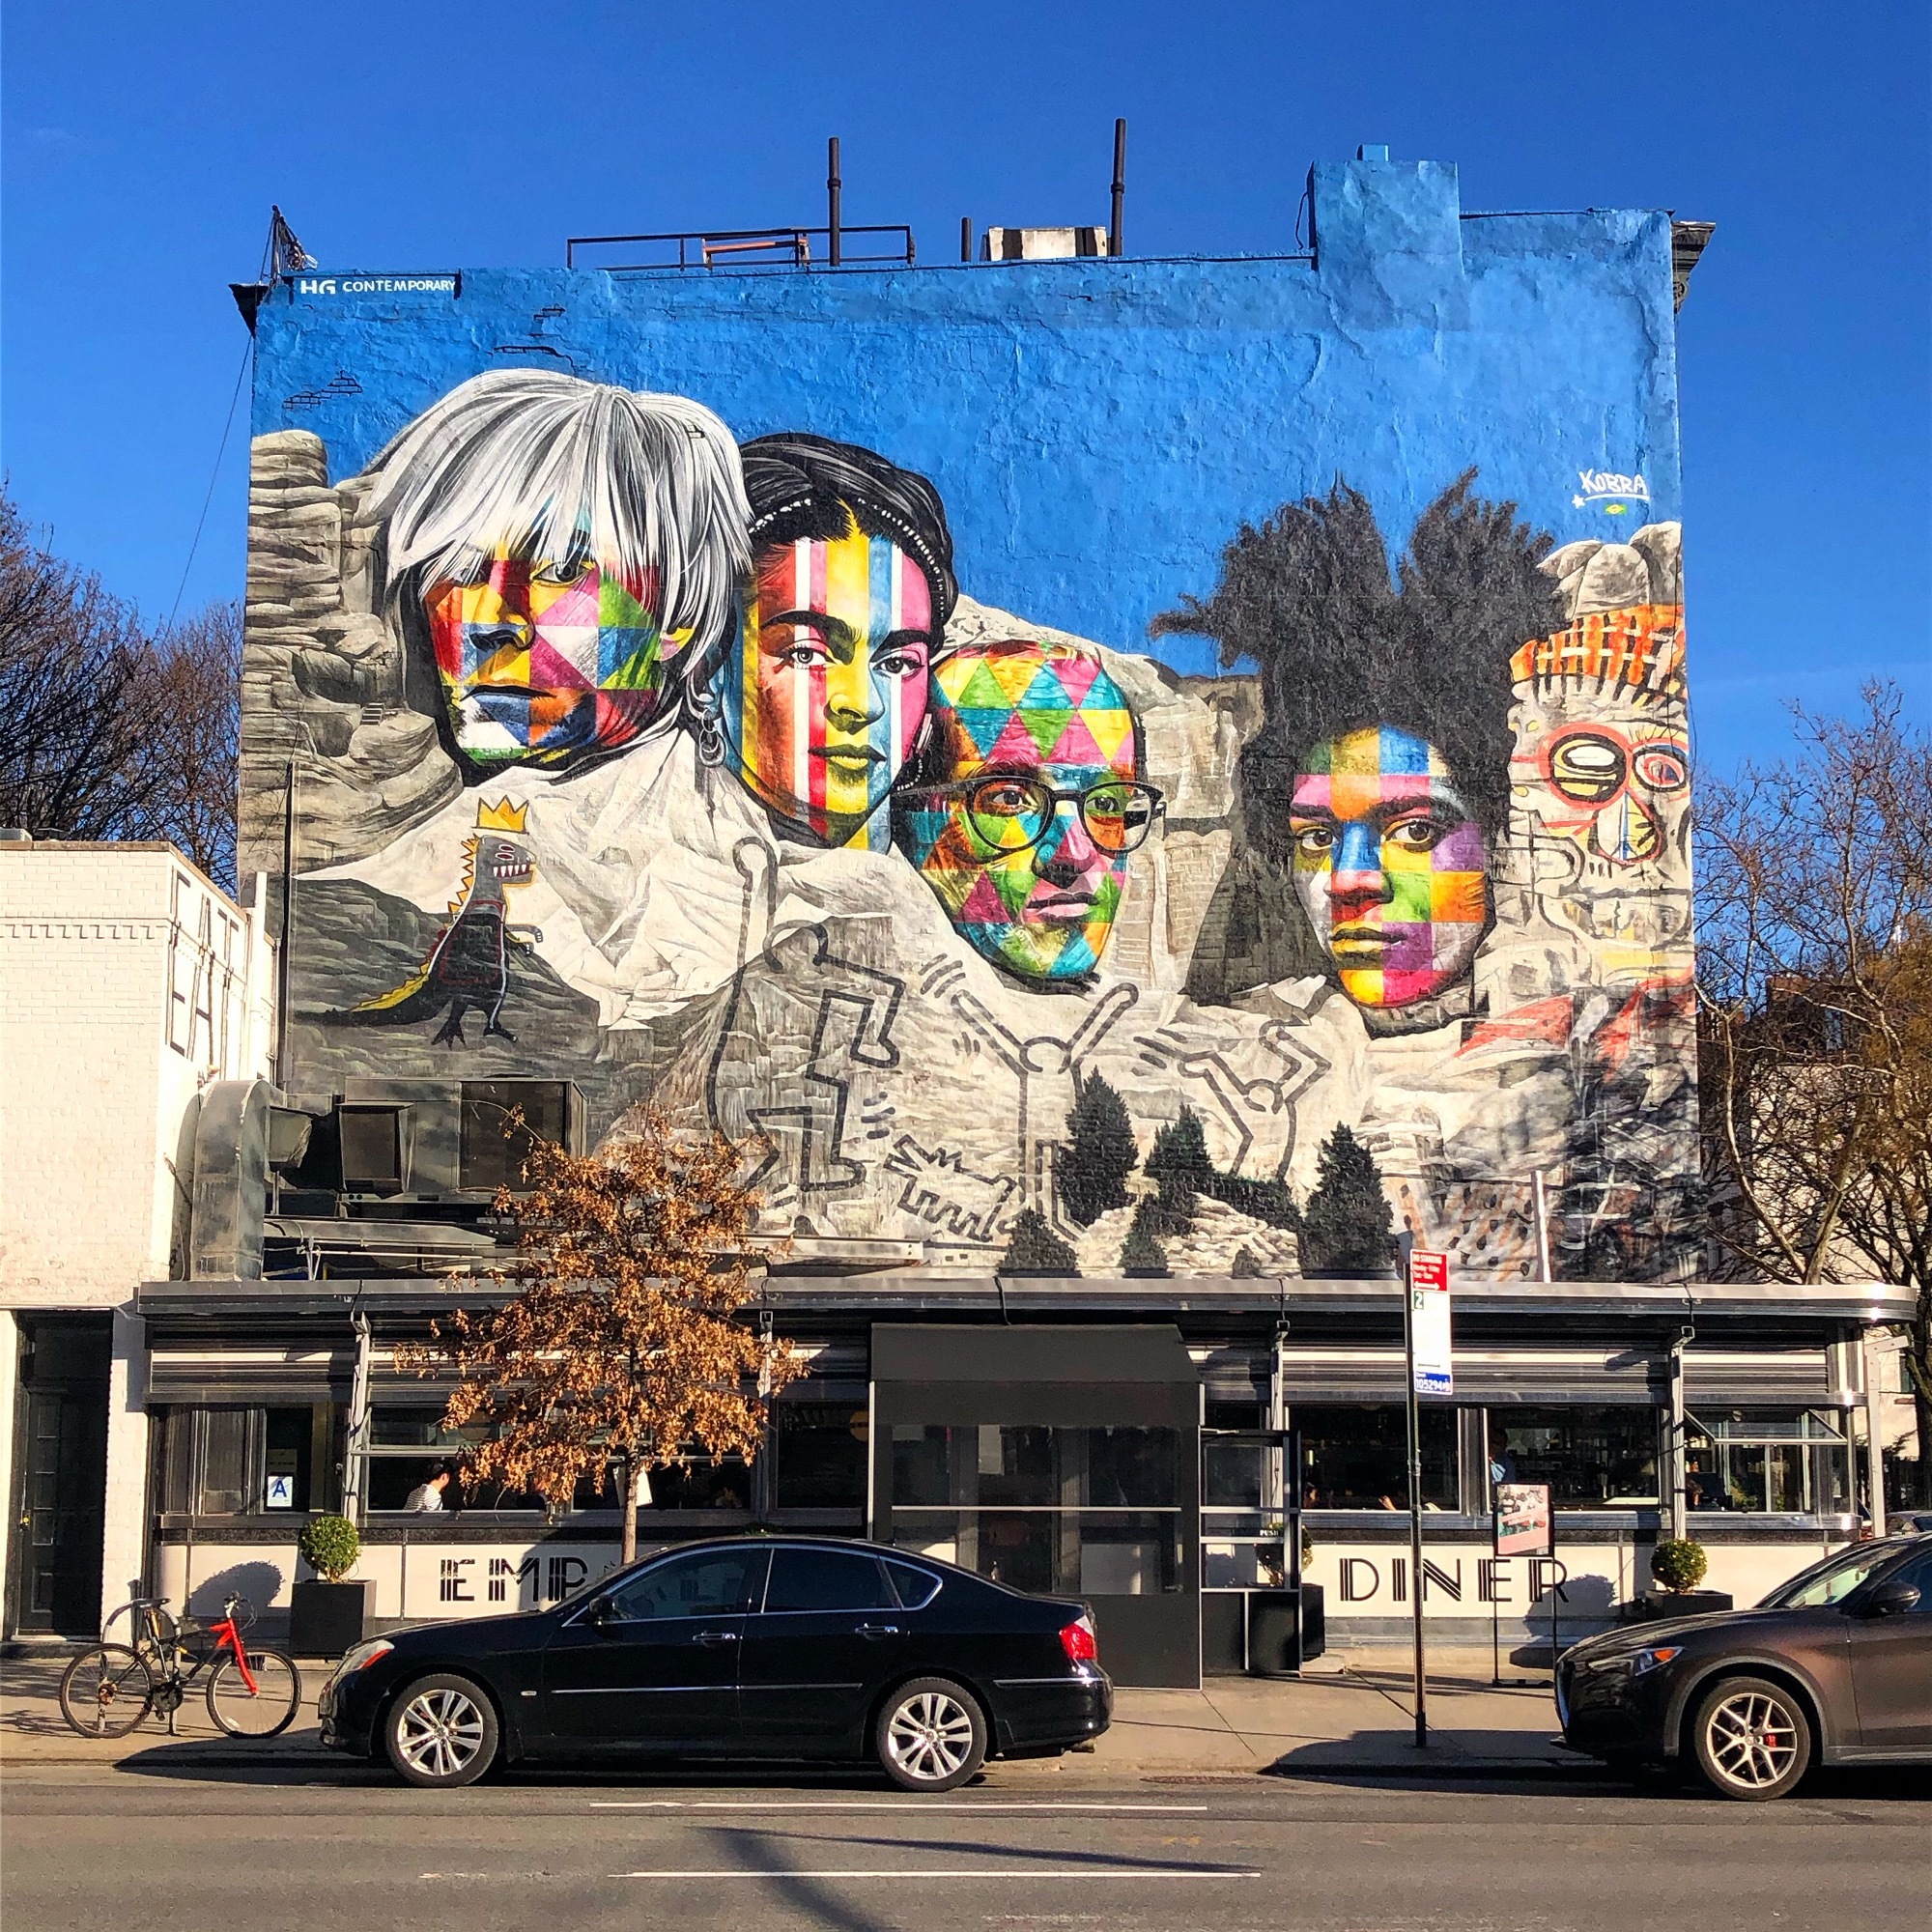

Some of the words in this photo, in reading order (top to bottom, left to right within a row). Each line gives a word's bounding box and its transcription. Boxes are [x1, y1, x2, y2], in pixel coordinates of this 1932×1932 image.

[300, 279, 336, 295] HG
[342, 279, 456, 293] CONTEMPORARY
[1578, 468, 1648, 495] KOBRA
[1415, 1292, 1423, 1309] 2
[1415, 1378, 1443, 1391] 105294
[271, 1480, 287, 1497] A
[440, 1556, 615, 1603] EMP
[1339, 1557, 1569, 1604] DINER
